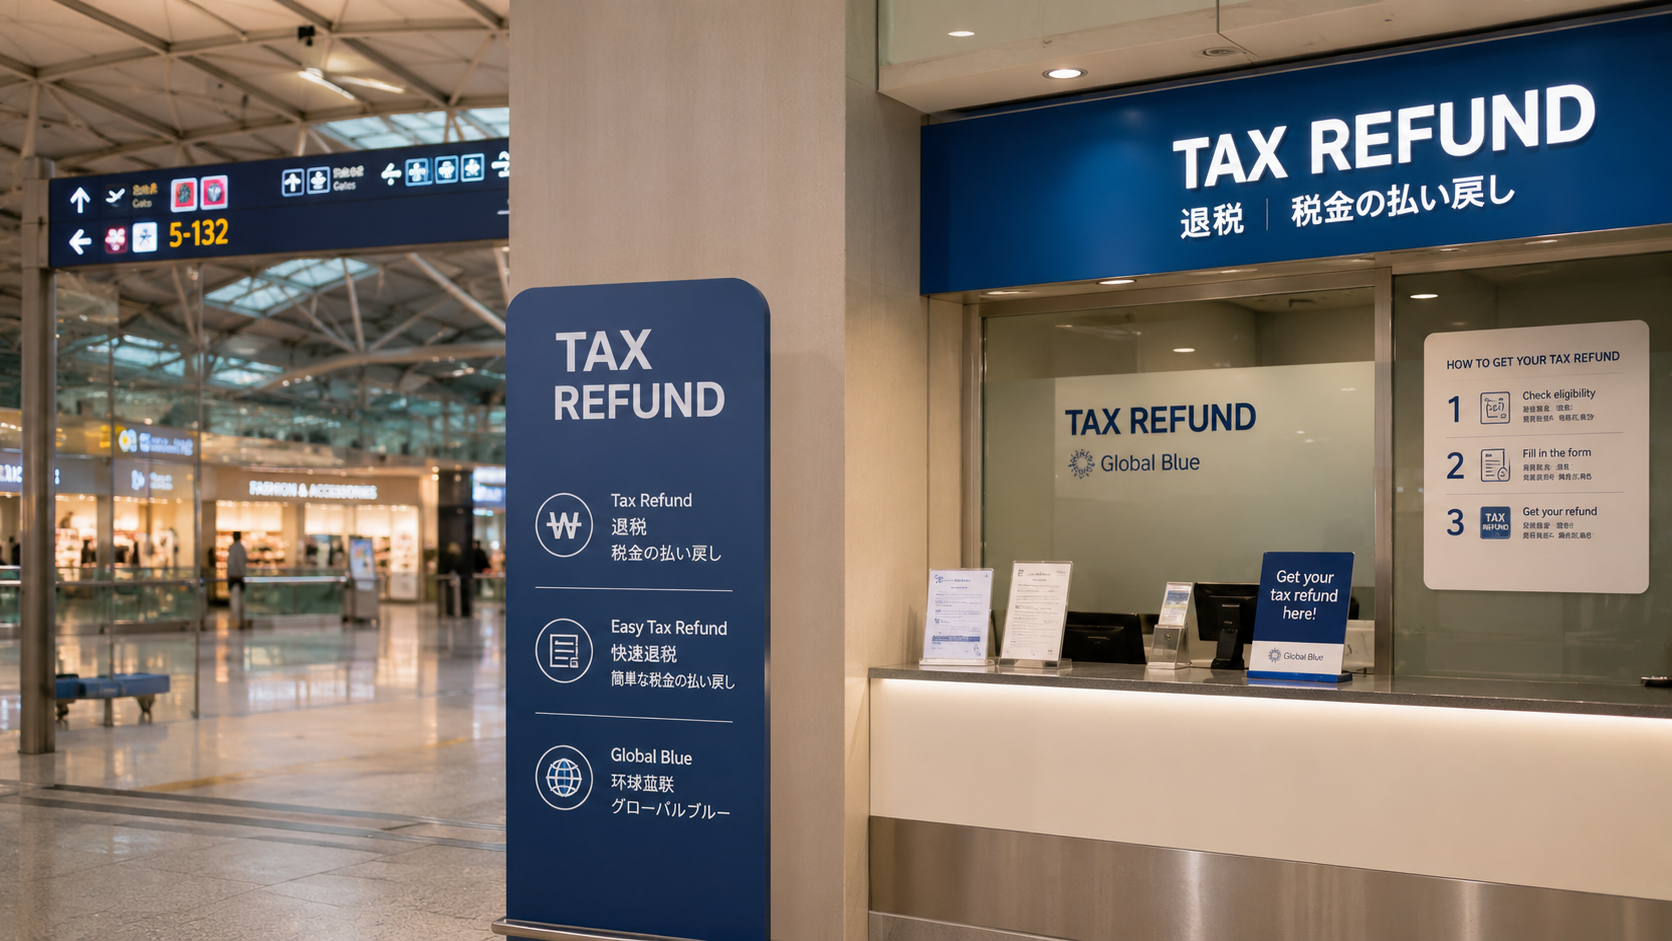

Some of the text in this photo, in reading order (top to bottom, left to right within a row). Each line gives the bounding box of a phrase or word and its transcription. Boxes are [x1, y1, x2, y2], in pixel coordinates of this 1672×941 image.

[1173, 84, 1596, 189] TAX REFUND
[1181, 175, 1515, 239] 退税 税金の払い戻し
[169, 218, 229, 248] 5-132
[556, 329, 652, 372] TAX
[1446, 350, 1621, 370] HOW TO GET YOUR TAX REFUND
[555, 382, 725, 420] REFUND
[1522, 387, 1597, 402] Check eligibility
[1449, 396, 1459, 422] 1
[1065, 403, 1256, 435] TAX REFUND
[1522, 447, 1592, 459] Fill in the form
[1101, 453, 1200, 472] Global Blue
[1447, 452, 1464, 479] 2
[610, 493, 692, 508] Tax Refund
[1485, 512, 1506, 523] TAX
[1522, 506, 1598, 519] Get your refund
[612, 518, 646, 536] 退税
[1447, 509, 1464, 536] 3
[612, 544, 721, 561] 税金の払い戻し
[1276, 569, 1334, 587] Get your
[1270, 588, 1338, 602] tax refund
[1283, 606, 1316, 620] here!
[612, 619, 727, 637] Easy Tax Refund
[611, 644, 677, 663] 快速退税
[1283, 651, 1324, 662] Global Blue
[612, 670, 735, 689] 簡単な税金の払い戻し
[611, 748, 692, 765] Global Blue
